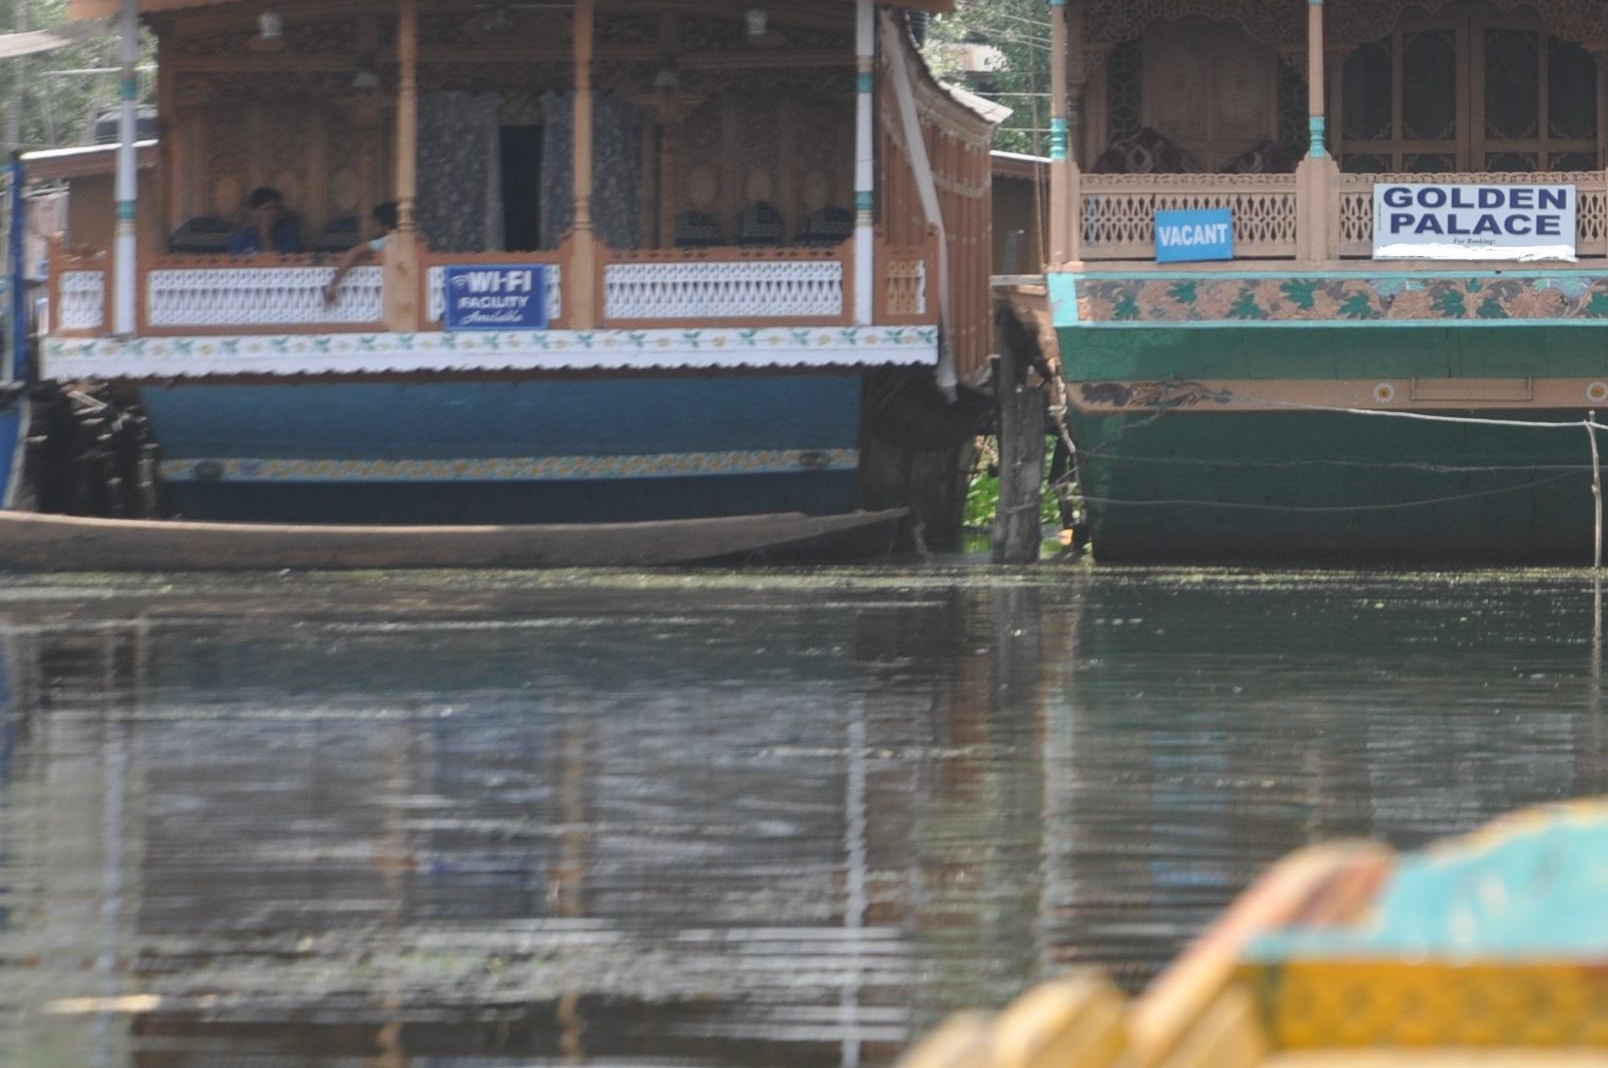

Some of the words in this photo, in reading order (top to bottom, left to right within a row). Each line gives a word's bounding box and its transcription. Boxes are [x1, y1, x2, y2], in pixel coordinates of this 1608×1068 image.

[1383, 186, 1567, 210] GOLDEN
[1158, 223, 1229, 246] VACANT
[1390, 213, 1562, 236] PALACE
[468, 270, 532, 293] WI-FI
[458, 295, 530, 309] FACILITY
